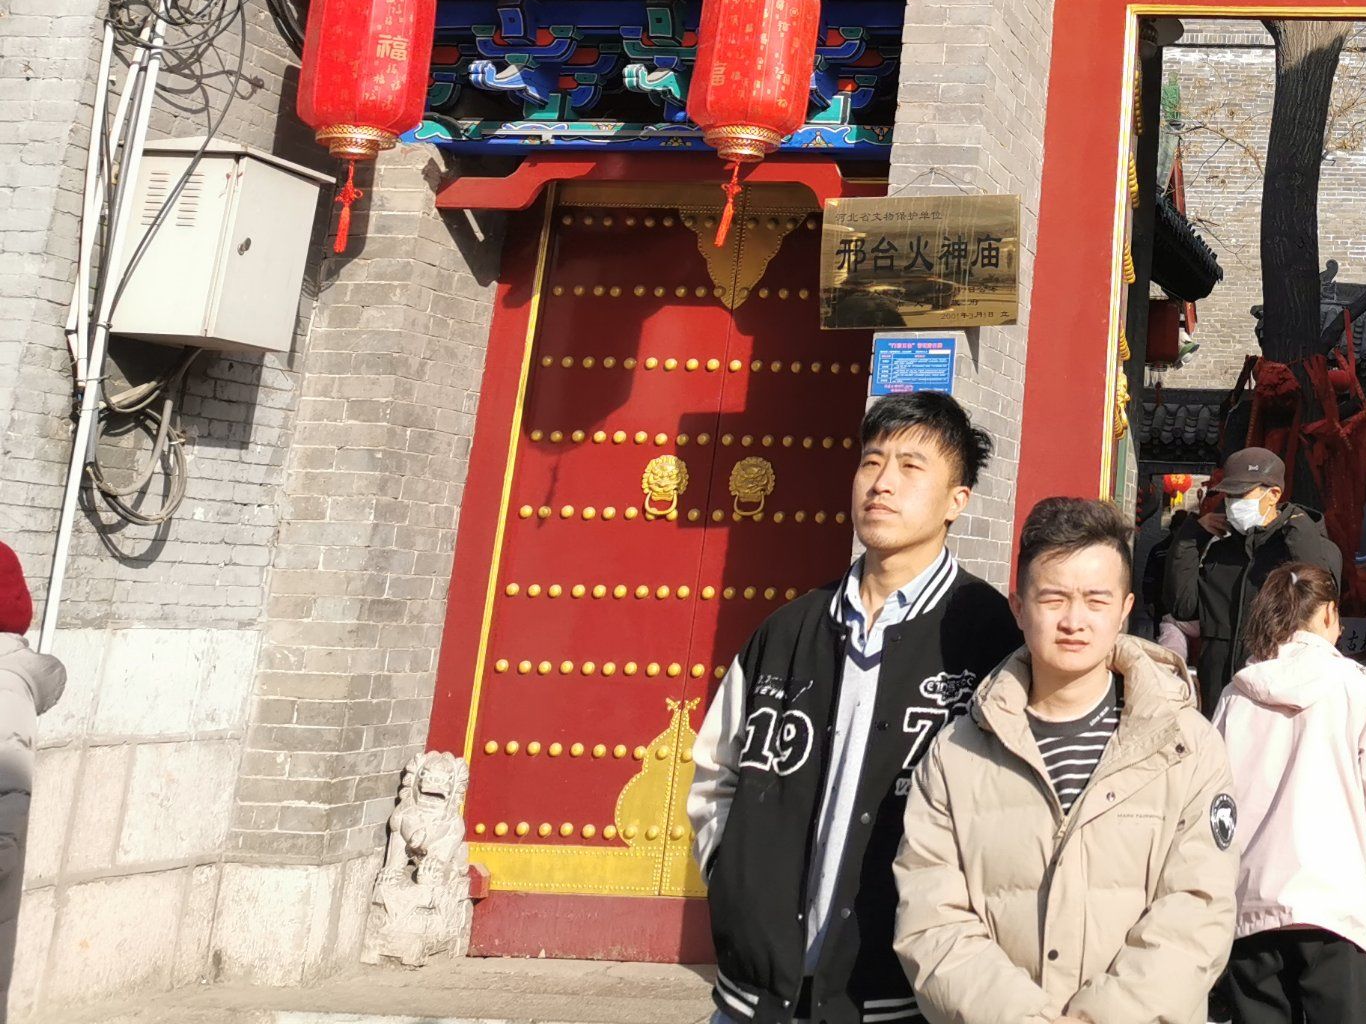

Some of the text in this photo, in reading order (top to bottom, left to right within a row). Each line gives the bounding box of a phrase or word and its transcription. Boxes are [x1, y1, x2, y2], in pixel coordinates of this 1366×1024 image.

[835, 210, 943, 224] 河北省文物保护单位
[835, 233, 1003, 274] 邢台火神庙
[739, 706, 814, 777] 19
[903, 706, 956, 770] 7
